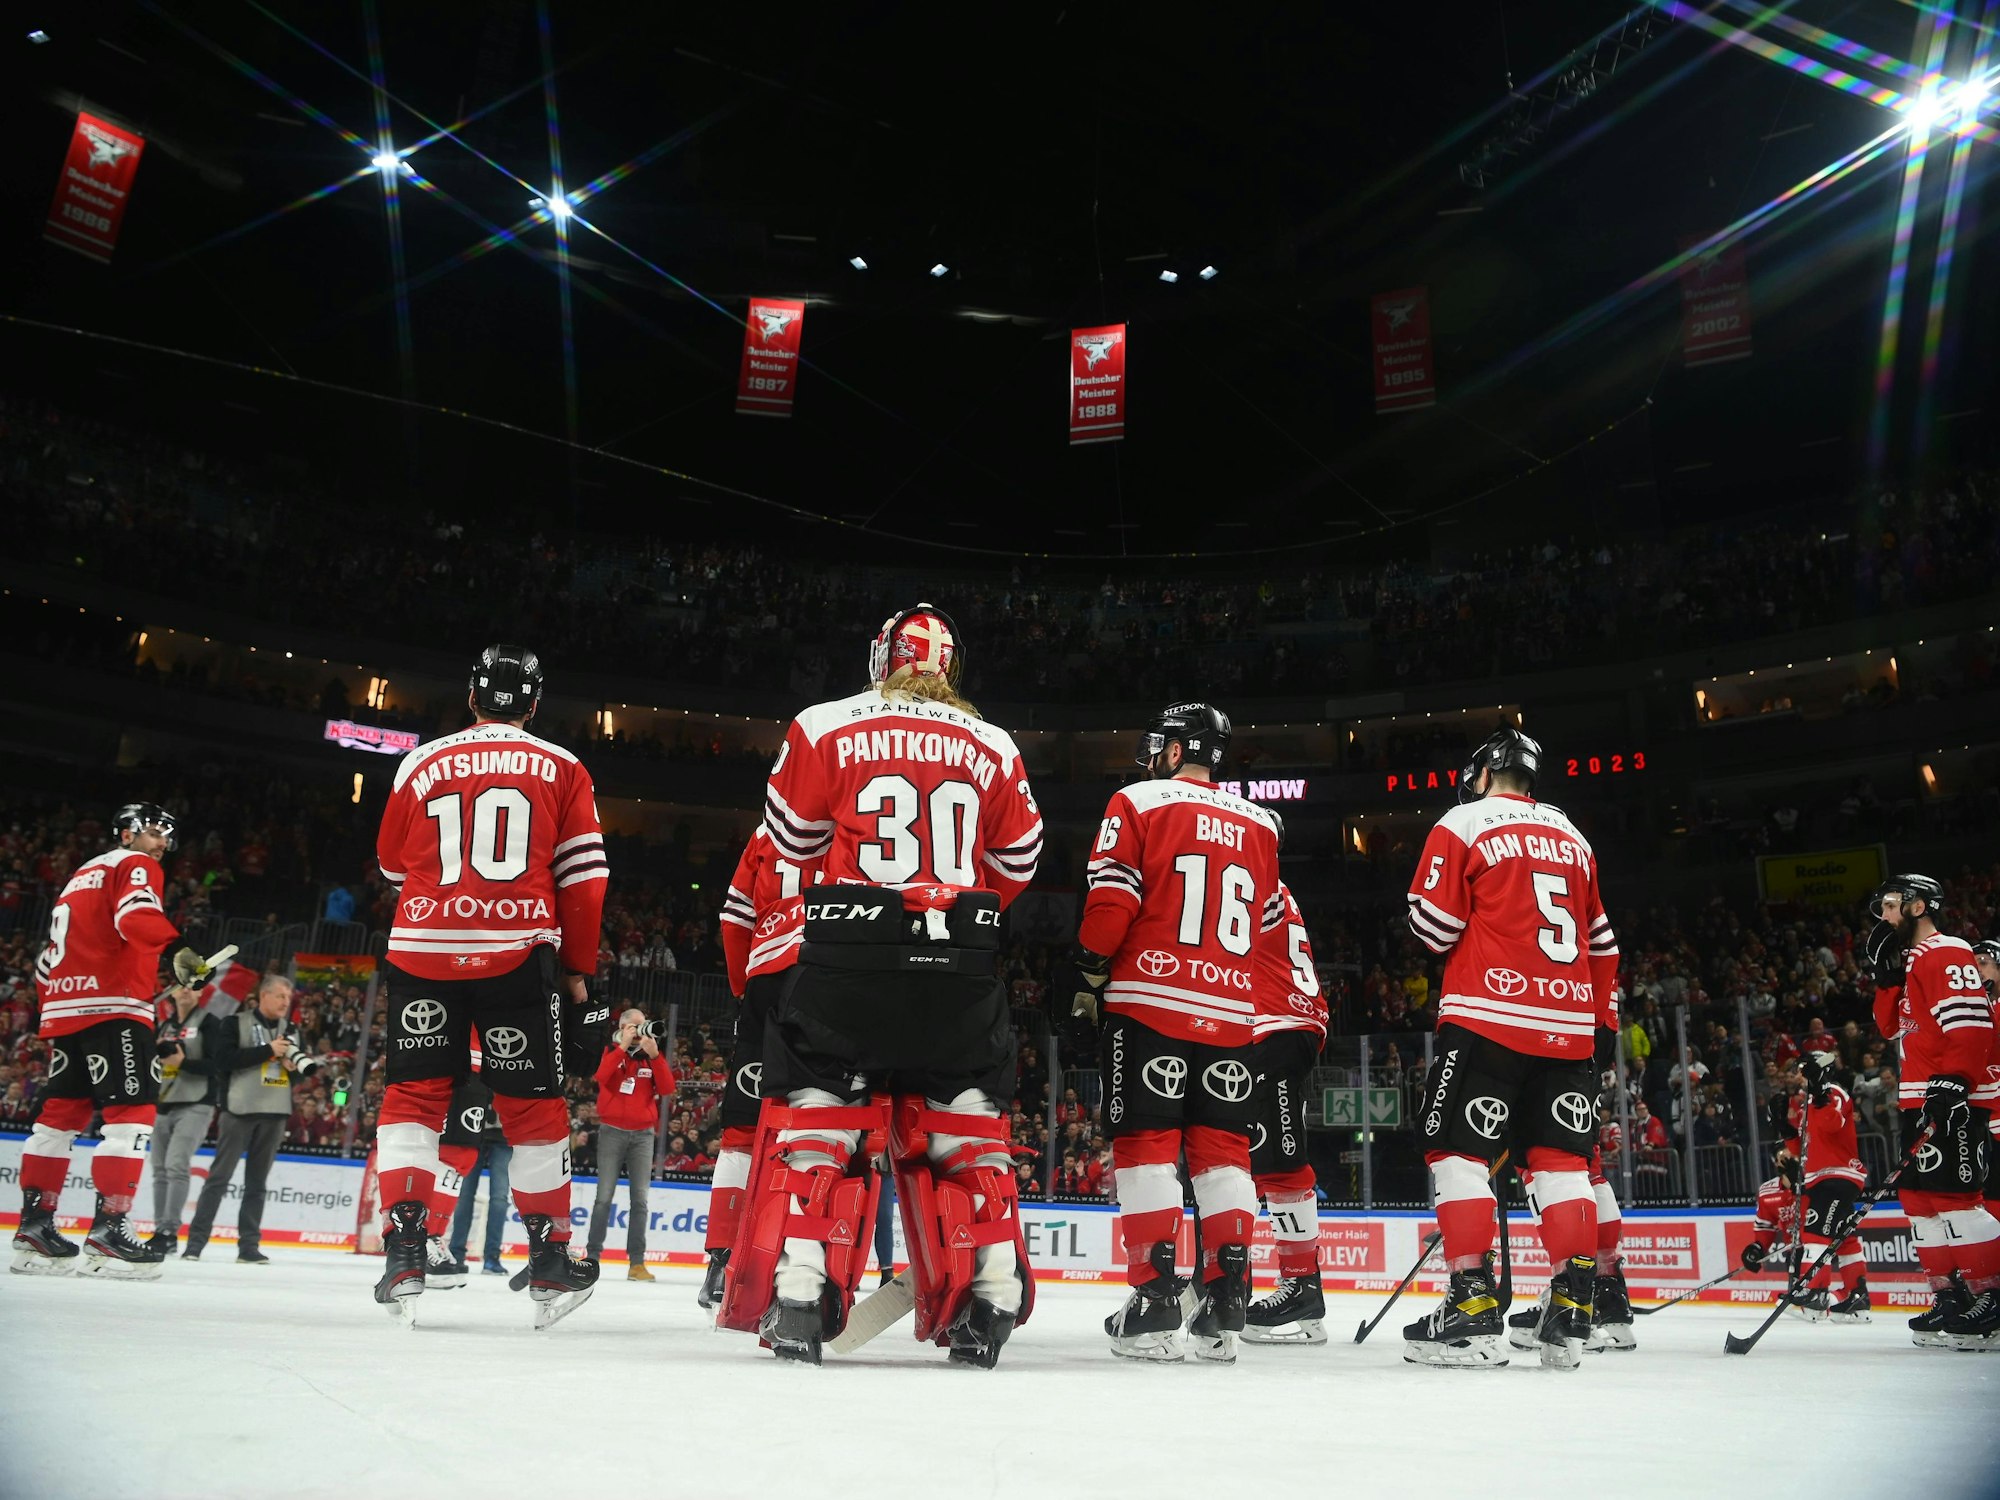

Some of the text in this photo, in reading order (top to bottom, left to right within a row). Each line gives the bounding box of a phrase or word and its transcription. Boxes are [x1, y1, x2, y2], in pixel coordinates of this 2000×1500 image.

[1691, 315, 1741, 338] 2002
[747, 345, 796, 359] Deutscher
[750, 360, 789, 373] Meister
[747, 376, 789, 392] 1987
[1074, 374, 1122, 386] Deutscher
[1383, 368, 1426, 387] 1995
[1079, 388, 1117, 399] Meister
[1078, 403, 1117, 419] 1988
[479, 676, 489, 688] 10
[521, 683, 532, 695] 10
[1163, 702, 1206, 717] STETSON
[1188, 739, 1201, 751] 16
[836, 728, 998, 792] PANTKOWSKI
[1566, 752, 1647, 777] 2023
[411, 750, 557, 802] MATSUMOTO
[1247, 779, 1306, 800] NOW
[425, 786, 532, 886] 10
[856, 774, 981, 888] 30
[1096, 815, 1122, 853] 16
[1196, 813, 1246, 852] BAST
[1475, 833, 1525, 868] VAN
[130, 866, 148, 886] 9
[1423, 855, 1445, 891] 5
[1795, 861, 1847, 879] Radio
[1803, 880, 1844, 896] Köln
[442, 895, 551, 920] TOYOTA
[806, 904, 884, 921] CCM
[1174, 854, 1255, 957] 16
[1929, 899, 1940, 910] 39
[1530, 871, 1580, 965] 5
[1944, 964, 1983, 991] 39
[121, 1028, 136, 1076] TOYOTA
[397, 1035, 450, 1051] TOYOTA
[553, 1019, 565, 1087] TOYOTA
[485, 1056, 535, 1071] TOYOTA
[1112, 1028, 1124, 1096] TOYOTA
[1432, 1049, 1459, 1110] TOYOTA
[1278, 1078, 1292, 1134] TOYOTA
[1826, 1199, 1840, 1224] TOYOTA
[1023, 1220, 1087, 1258] ETL
[1346, 1228, 1369, 1240] Haie
[1656, 1236, 1691, 1249] HAIE!
[1627, 1254, 1679, 1266] HAIE.DE
